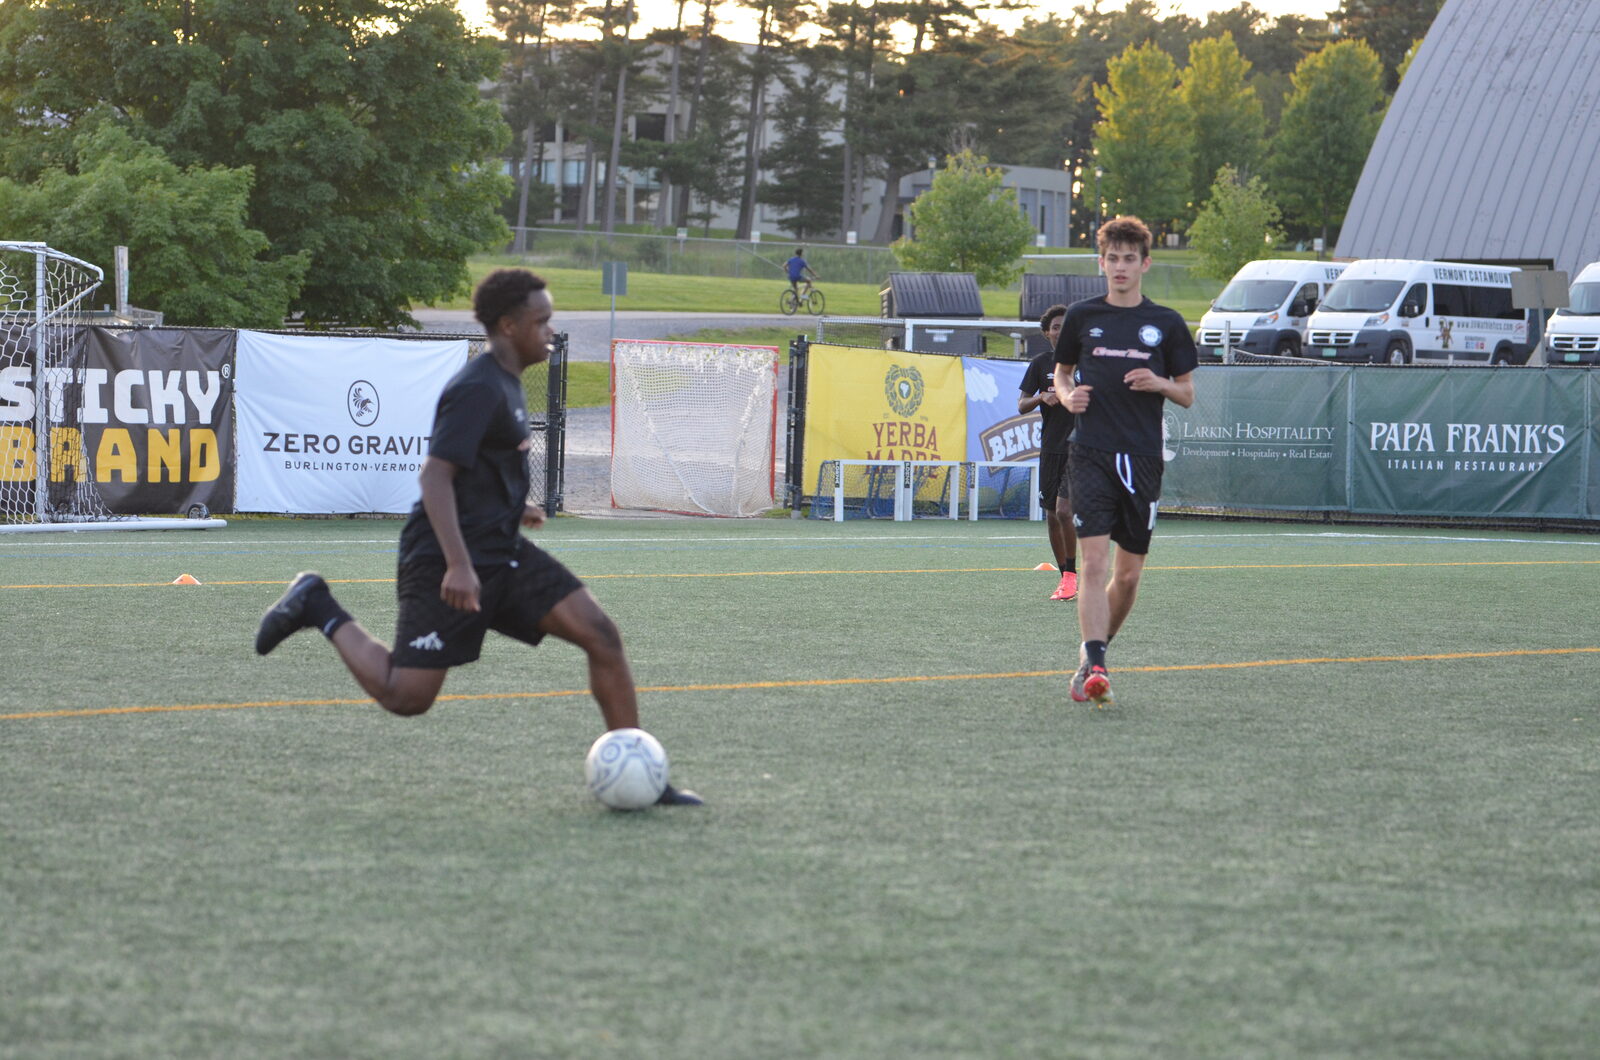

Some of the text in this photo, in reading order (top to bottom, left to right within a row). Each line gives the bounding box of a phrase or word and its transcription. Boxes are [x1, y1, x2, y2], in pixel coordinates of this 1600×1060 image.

[1433, 268, 1467, 281] VERMONT
[263, 432, 340, 454] ZERO
[873, 422, 938, 451] YERBA
[1370, 422, 1565, 454] PAPA FRANK'S
[0, 426, 220, 483] BRAND
[1182, 447, 1332, 461] Development Hospitality Real Estat
[1388, 459, 1544, 473] ITALIAN RESTAURANT
